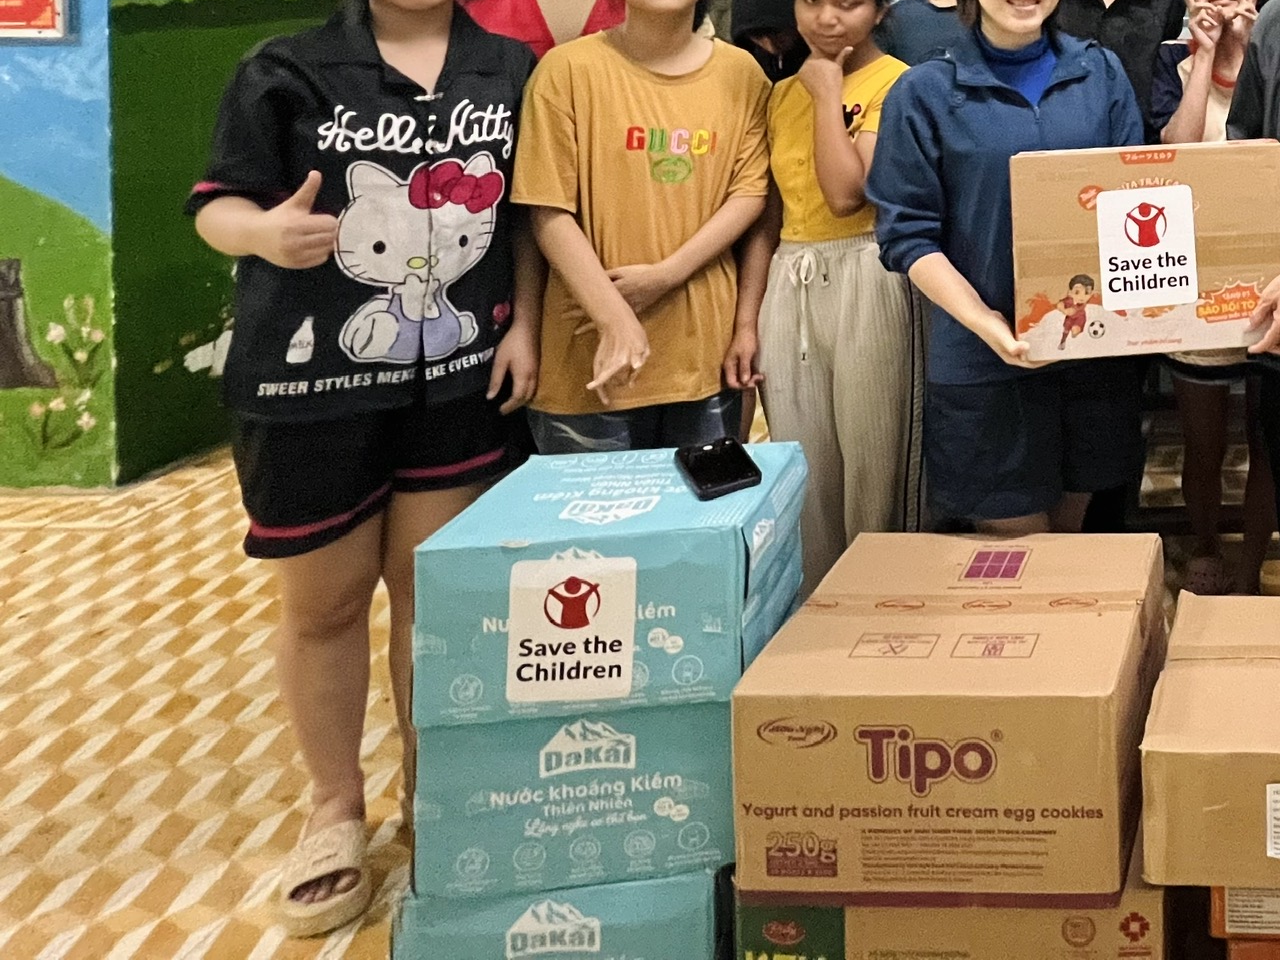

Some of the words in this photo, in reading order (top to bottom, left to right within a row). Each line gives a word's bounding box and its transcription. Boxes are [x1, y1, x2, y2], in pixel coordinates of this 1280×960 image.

[626, 125, 718, 156] GUCCI
[1108, 256, 1153, 273] Save
[1156, 252, 1188, 269] the
[1108, 272, 1190, 293] Children
[314, 373, 372, 393] STYLES
[518, 638, 577, 657] Save
[583, 635, 623, 654] the
[516, 661, 622, 682] Children
[856, 725, 997, 797] Tipo
[490, 787, 544, 808] Nước
[742, 804, 798, 820] Yogurt
[802, 804, 834, 818] and
[839, 804, 903, 820] passion
[907, 803, 941, 819] fruit
[945, 807, 999, 819] cream
[1004, 806, 1035, 822] egg
[1041, 803, 1104, 819] cookies
[767, 831, 838, 862] 250g
